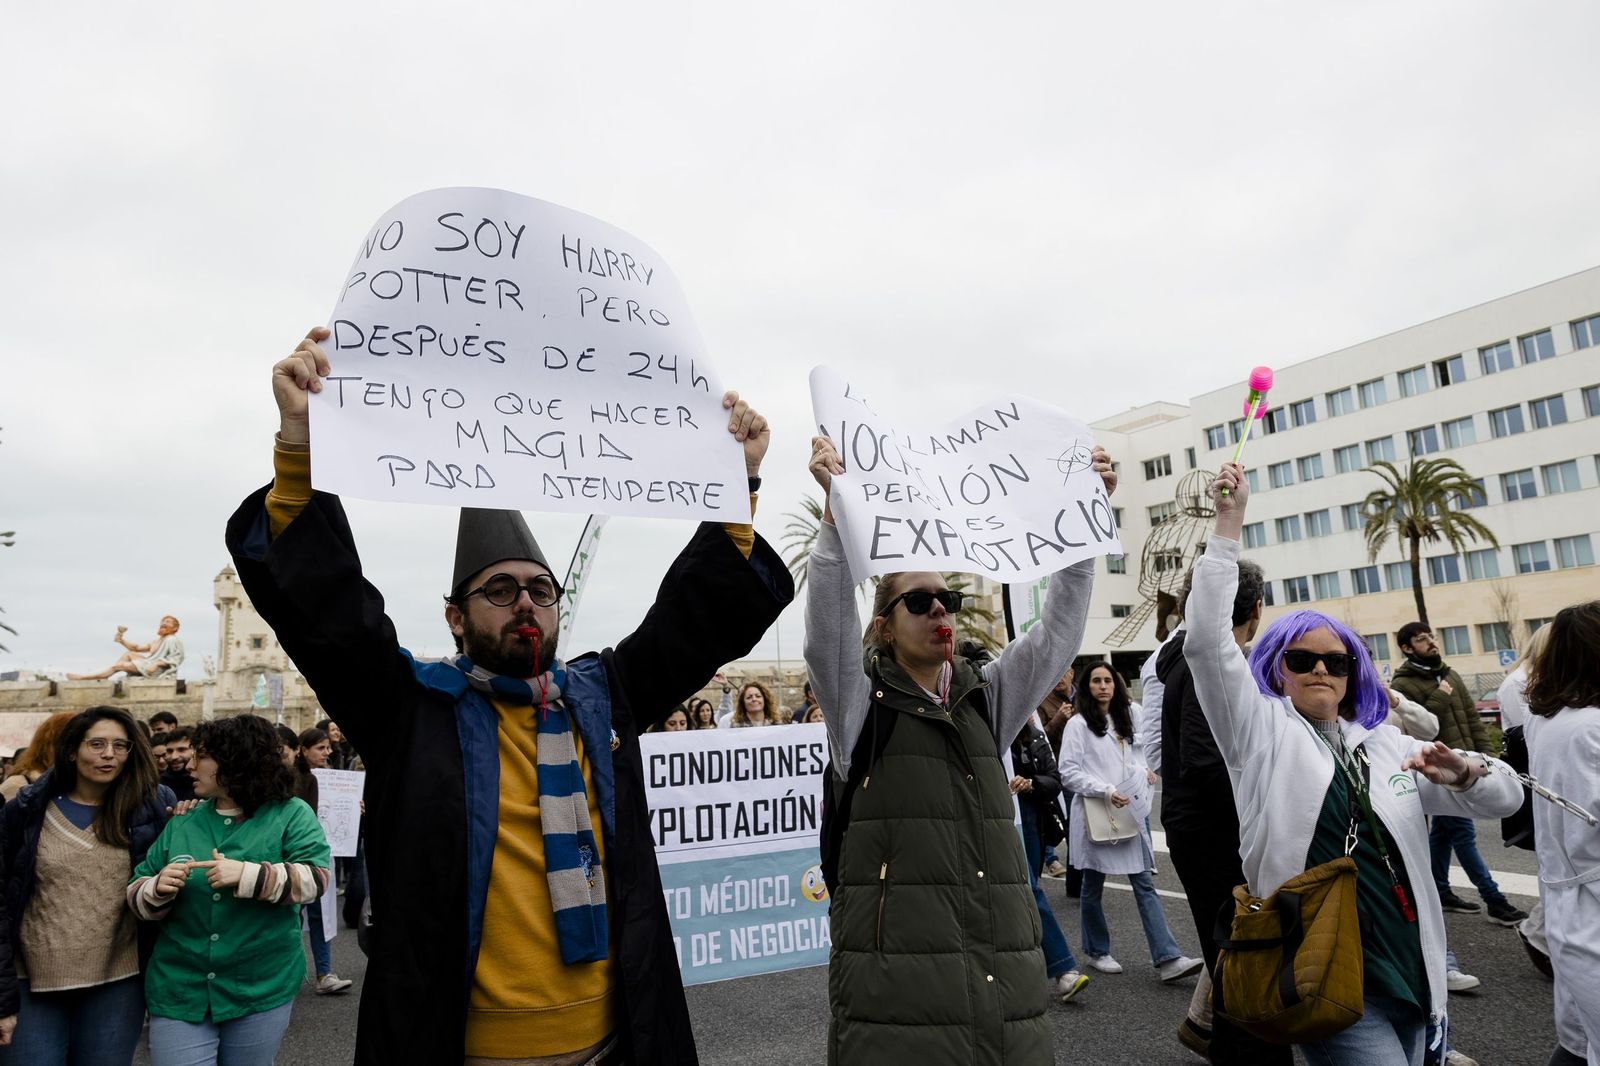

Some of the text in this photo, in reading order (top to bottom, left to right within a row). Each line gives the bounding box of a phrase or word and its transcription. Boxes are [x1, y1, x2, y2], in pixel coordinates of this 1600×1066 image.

[354, 213, 654, 286] NO SOY HARRY
[576, 286, 671, 327] PERO
[542, 346, 597, 373] DE
[626, 352, 710, 393] 24h
[326, 376, 699, 430] TENGO QUE HACER
[455, 420, 633, 470] MAGIA
[890, 402, 1021, 457] LAMAN
[377, 454, 725, 510] PARA ATENDERTE
[965, 515, 1005, 532] ES
[649, 742, 824, 789] CONDICIONES
[700, 874, 796, 917] MÉDICO,
[690, 930, 723, 968] DE
[729, 914, 834, 962] NEGOCIA
